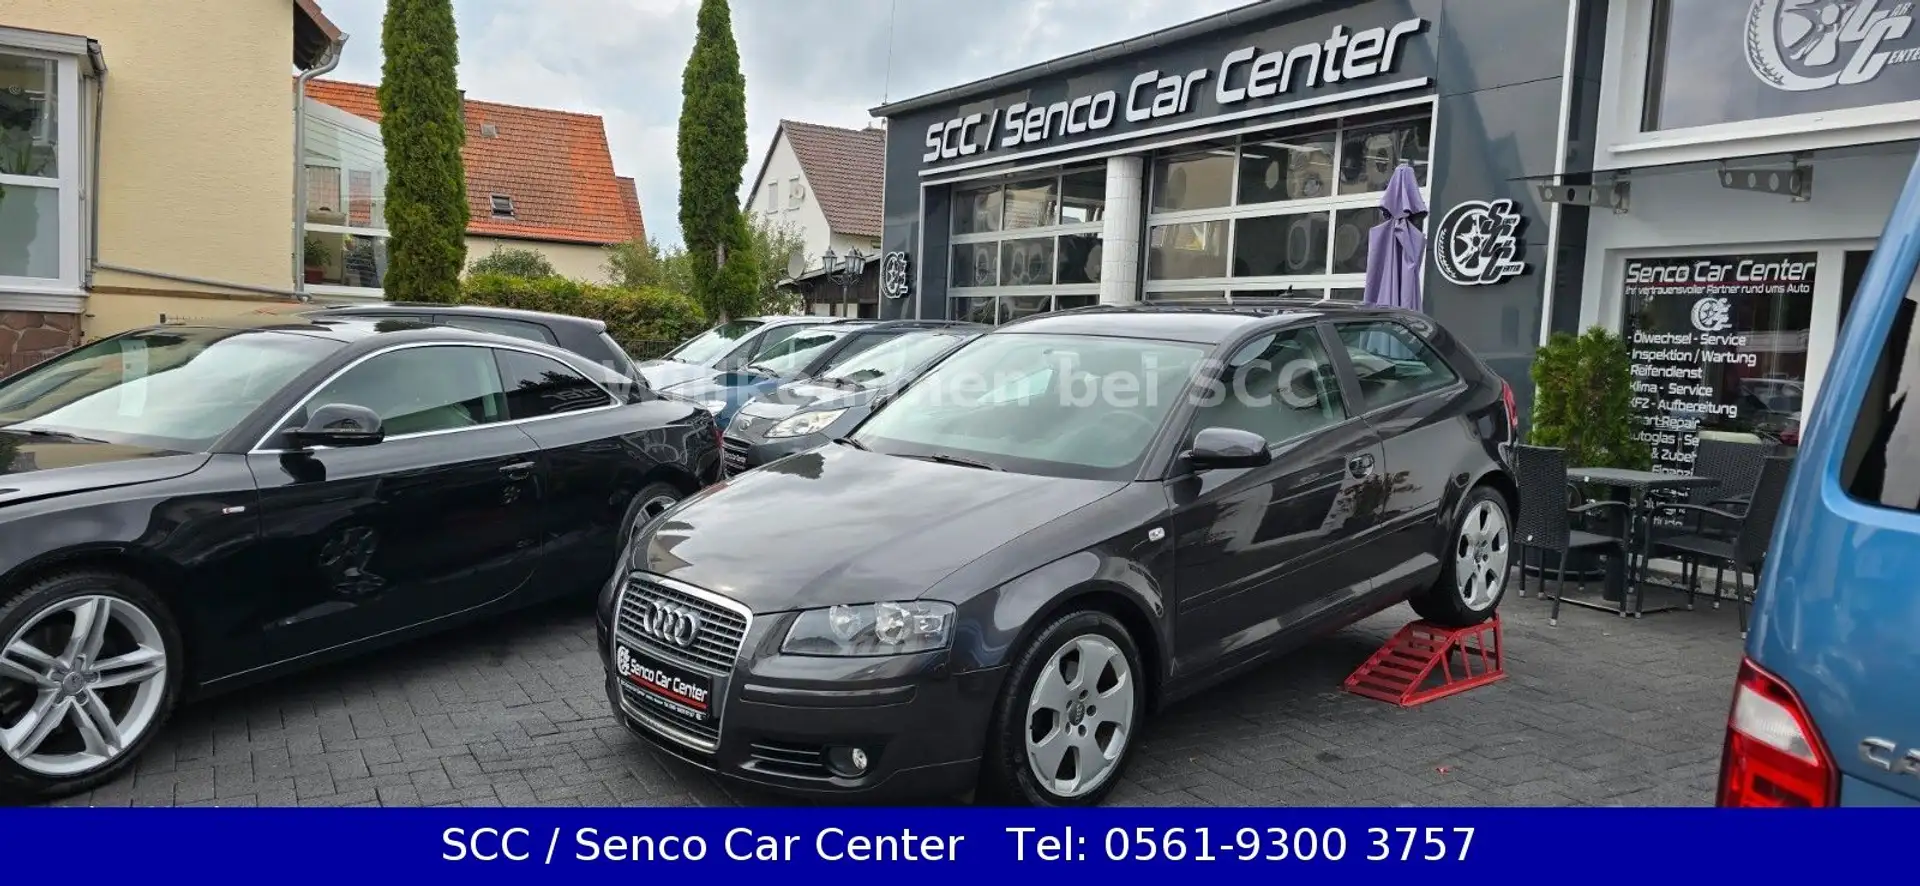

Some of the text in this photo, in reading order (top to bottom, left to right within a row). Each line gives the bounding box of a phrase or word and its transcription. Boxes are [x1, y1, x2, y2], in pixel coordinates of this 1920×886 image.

[923, 18, 1424, 162] SCC / Senco Car Center
[1626, 257, 1816, 283] Senco Car Center
[1706, 284, 1740, 294] Partner
[1742, 283, 1764, 294] rund
[1766, 284, 1784, 293] ums
[1787, 282, 1810, 293] Auto
[1633, 330, 1692, 345] Ölwechsel
[1700, 333, 1746, 346] Service
[1632, 348, 1692, 362] Inspektion
[1693, 348, 1700, 364] /
[1701, 350, 1757, 367] Wartung
[1630, 364, 1703, 379] Reifendienst
[1668, 383, 1713, 397] Service
[1657, 399, 1738, 418] Aufbereitung
[1651, 447, 1659, 459] &
[630, 658, 655, 682] Senco
[655, 670, 672, 689] Car
[672, 677, 708, 702] Center
